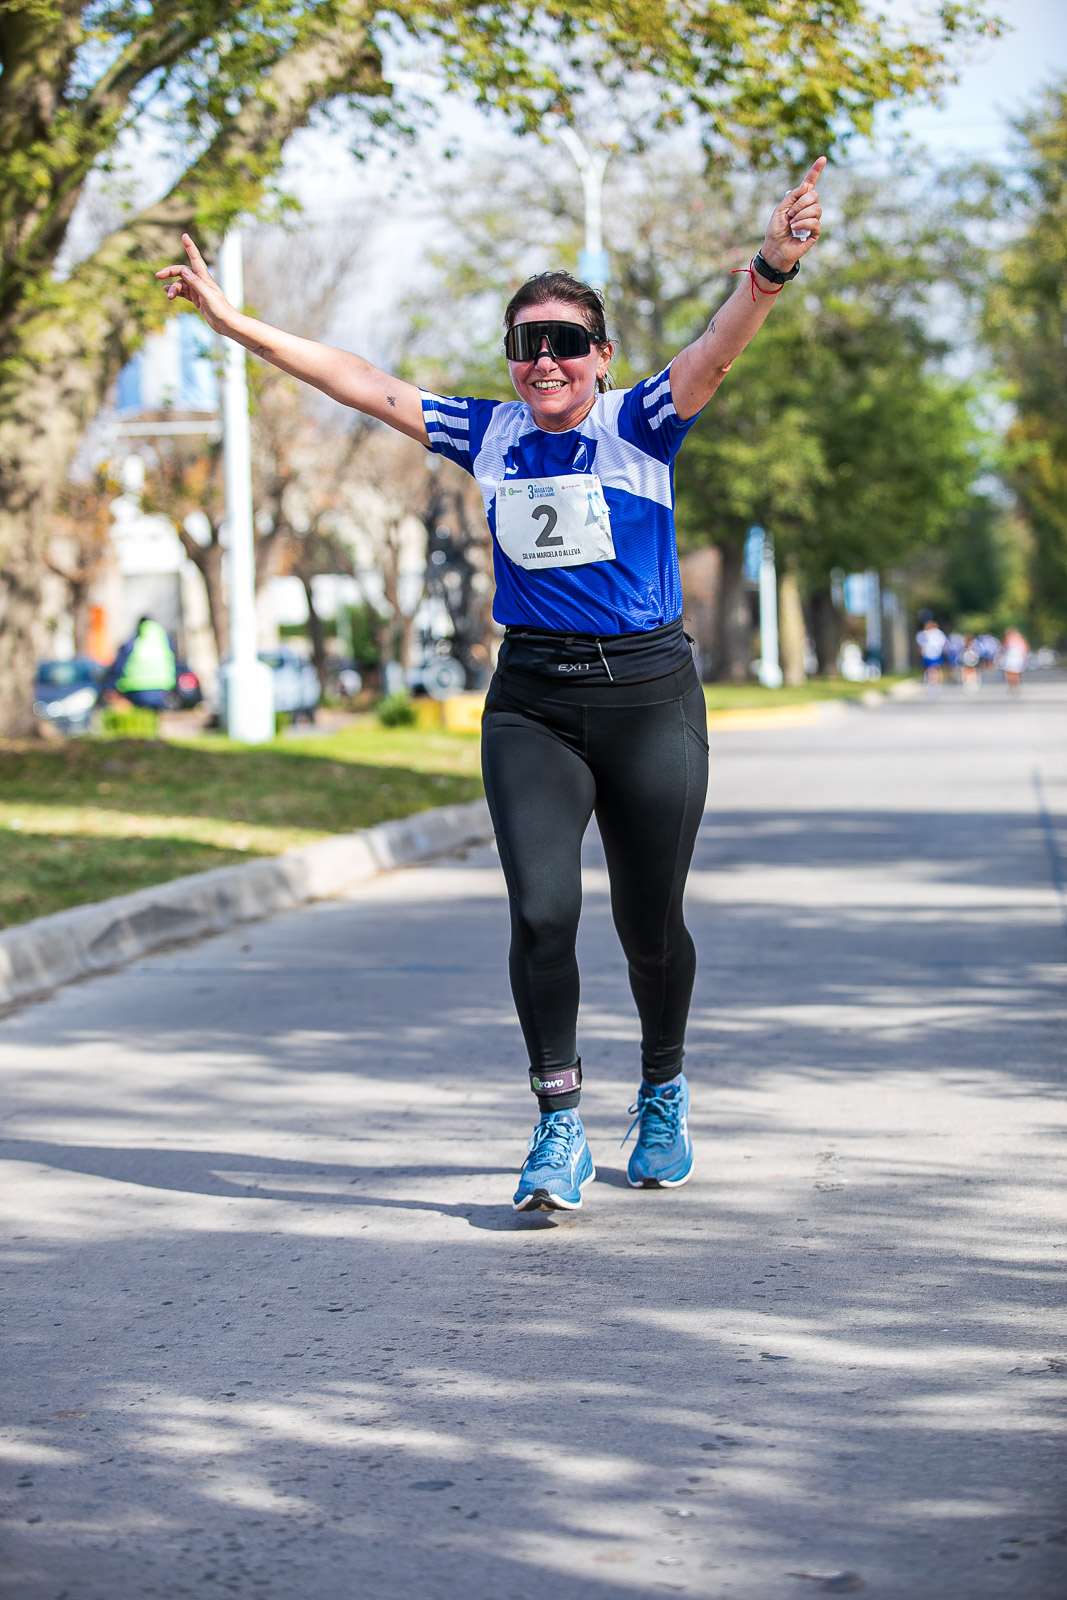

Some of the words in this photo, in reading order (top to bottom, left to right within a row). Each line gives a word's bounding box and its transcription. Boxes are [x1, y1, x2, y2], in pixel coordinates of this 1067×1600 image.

[531, 505, 564, 547] 2
[522, 552, 537, 560] SILVIA
[536, 550, 559, 559] MARCELA
[563, 548, 581, 556] ALLEVA
